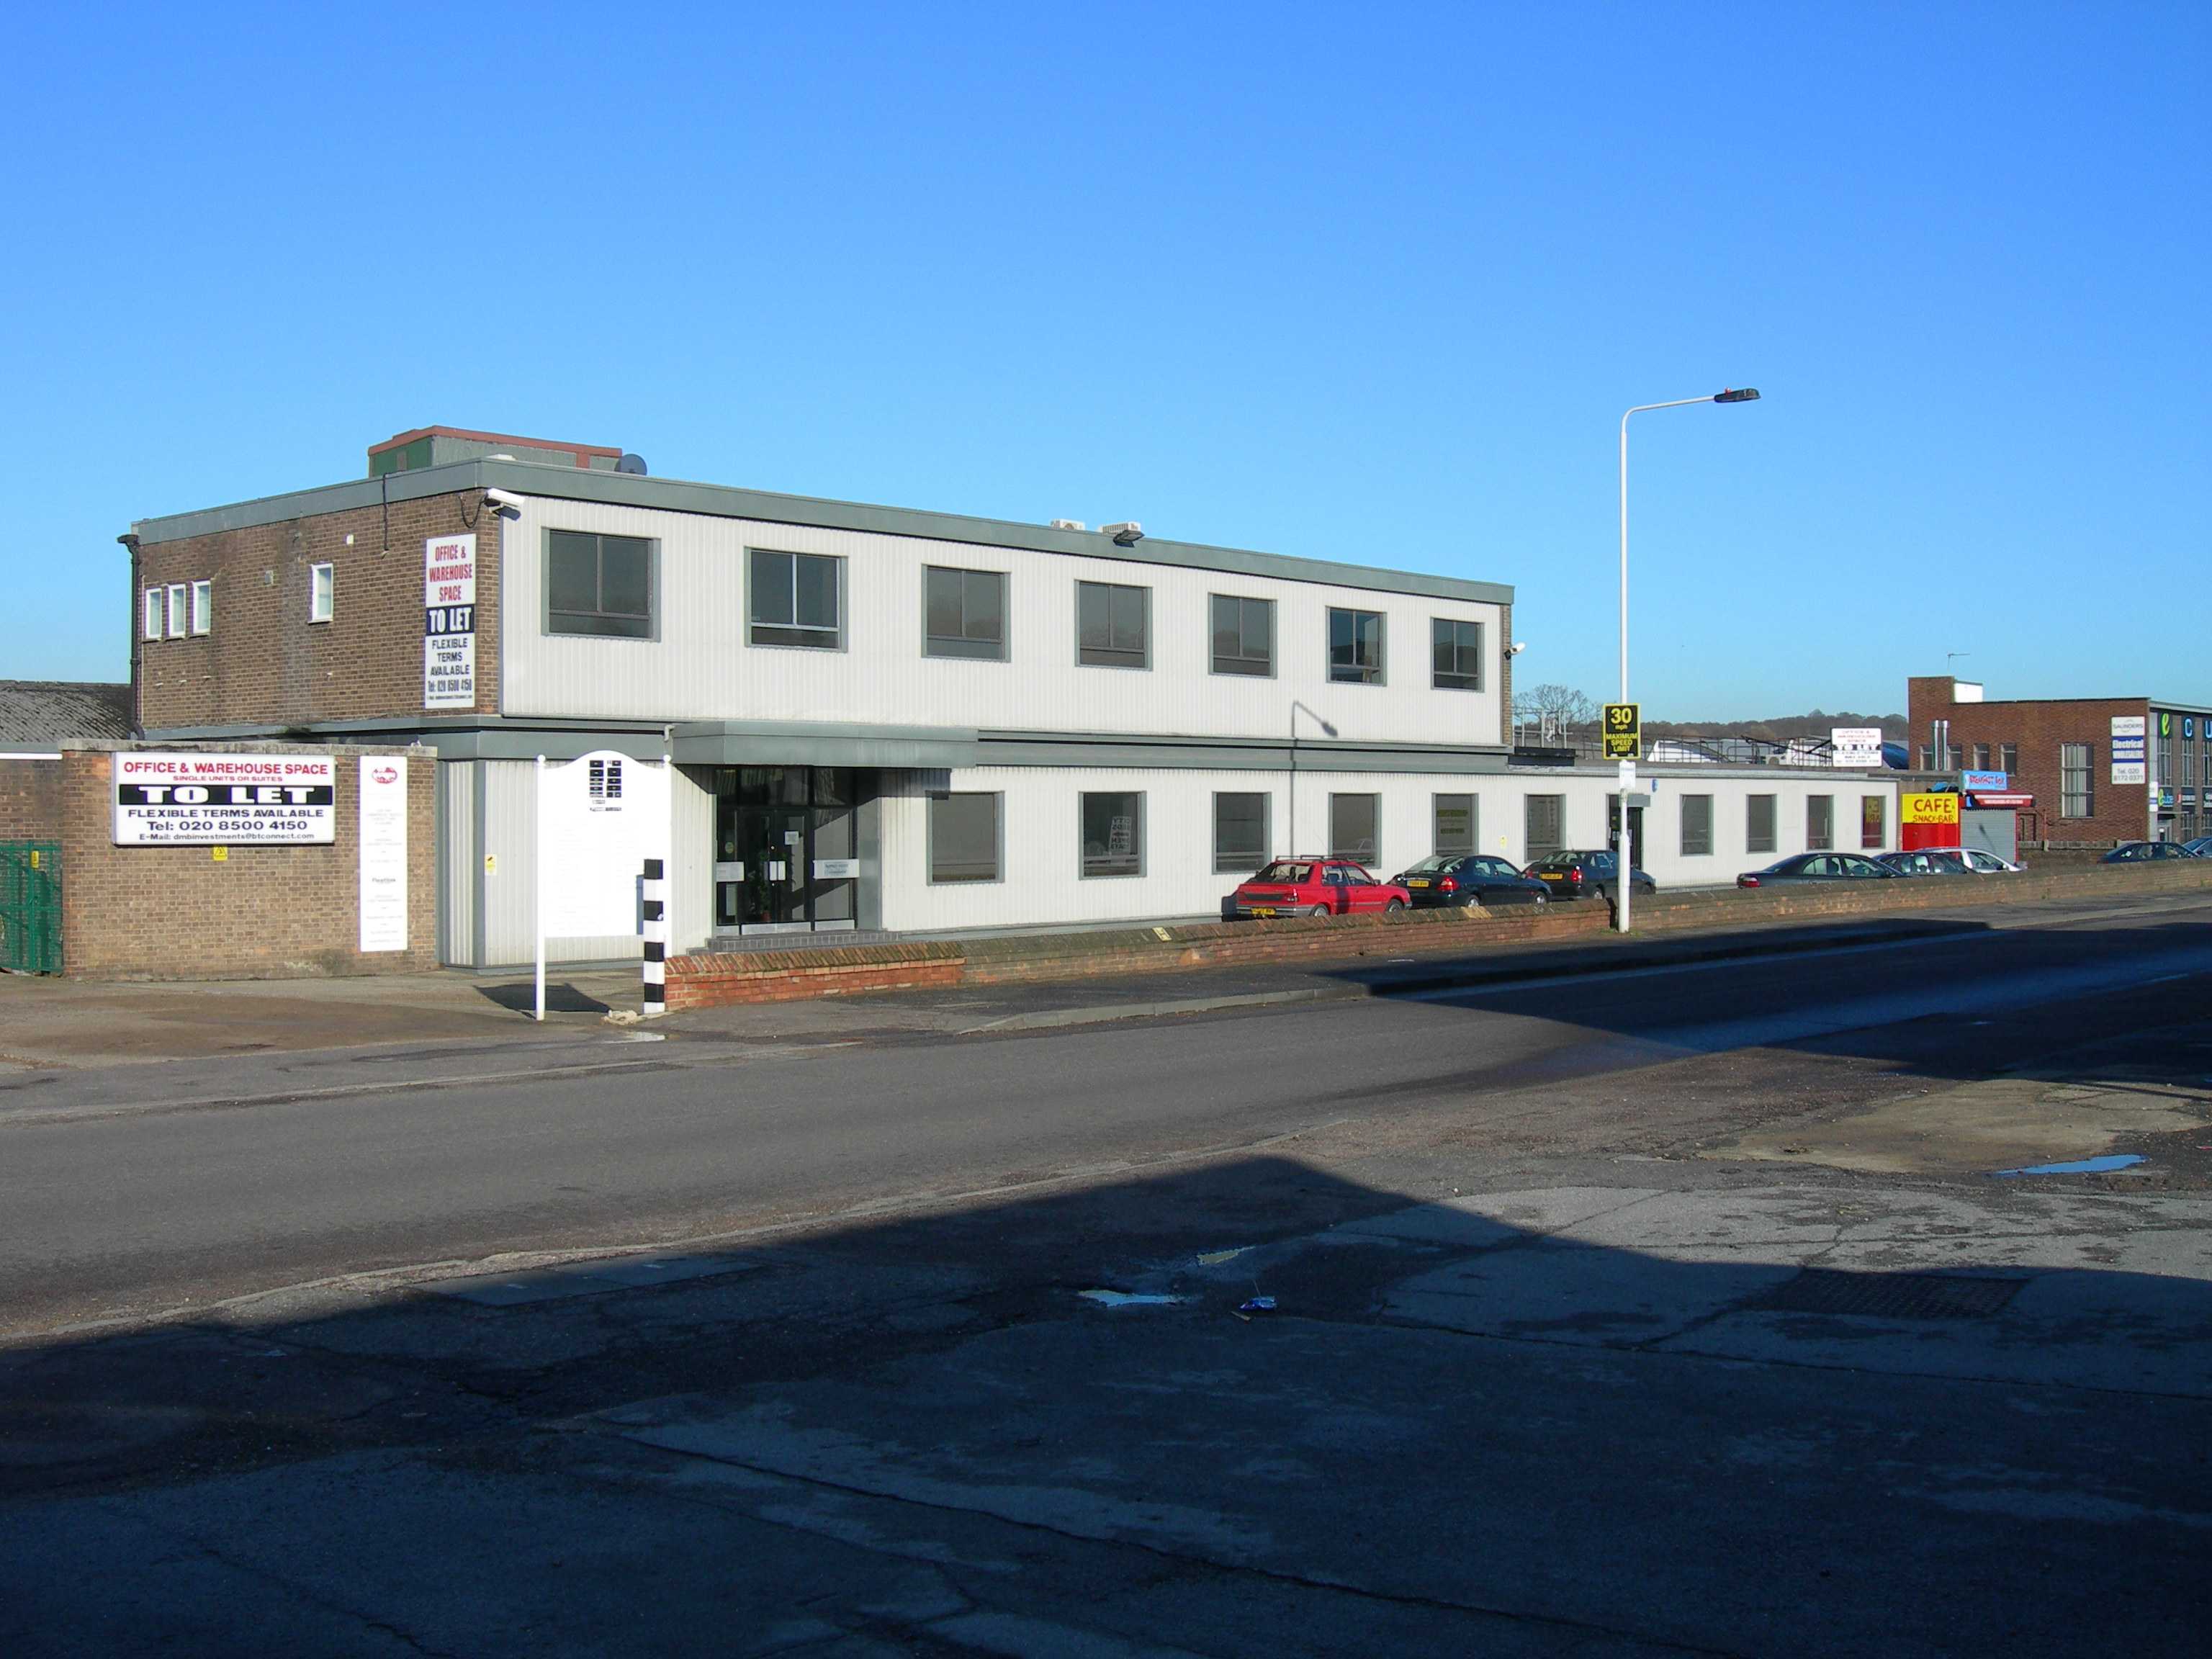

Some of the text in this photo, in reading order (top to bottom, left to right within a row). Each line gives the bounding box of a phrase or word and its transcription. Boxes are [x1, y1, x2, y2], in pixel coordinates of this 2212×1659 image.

[434, 544, 467, 562] OFFICE &
[429, 563, 472, 583] WAREHOUSE
[439, 585, 462, 603] SPACE
[429, 606, 472, 633] TO LET
[432, 637, 468, 649] FLEXIBLE
[437, 651, 463, 662] TERMS
[431, 664, 470, 676] AVAILABLE
[1611, 707, 1632, 724] 30
[124, 761, 328, 775] OFFICE & WAREHOUSE SPACE
[138, 786, 315, 804] TO LET
[128, 809, 198, 817] FLEXIBLE
[1913, 798, 1952, 814] CAFE
[147, 821, 307, 831] Tel: 020 8500 4150
[1912, 814, 1955, 824] SNACK-BAR
